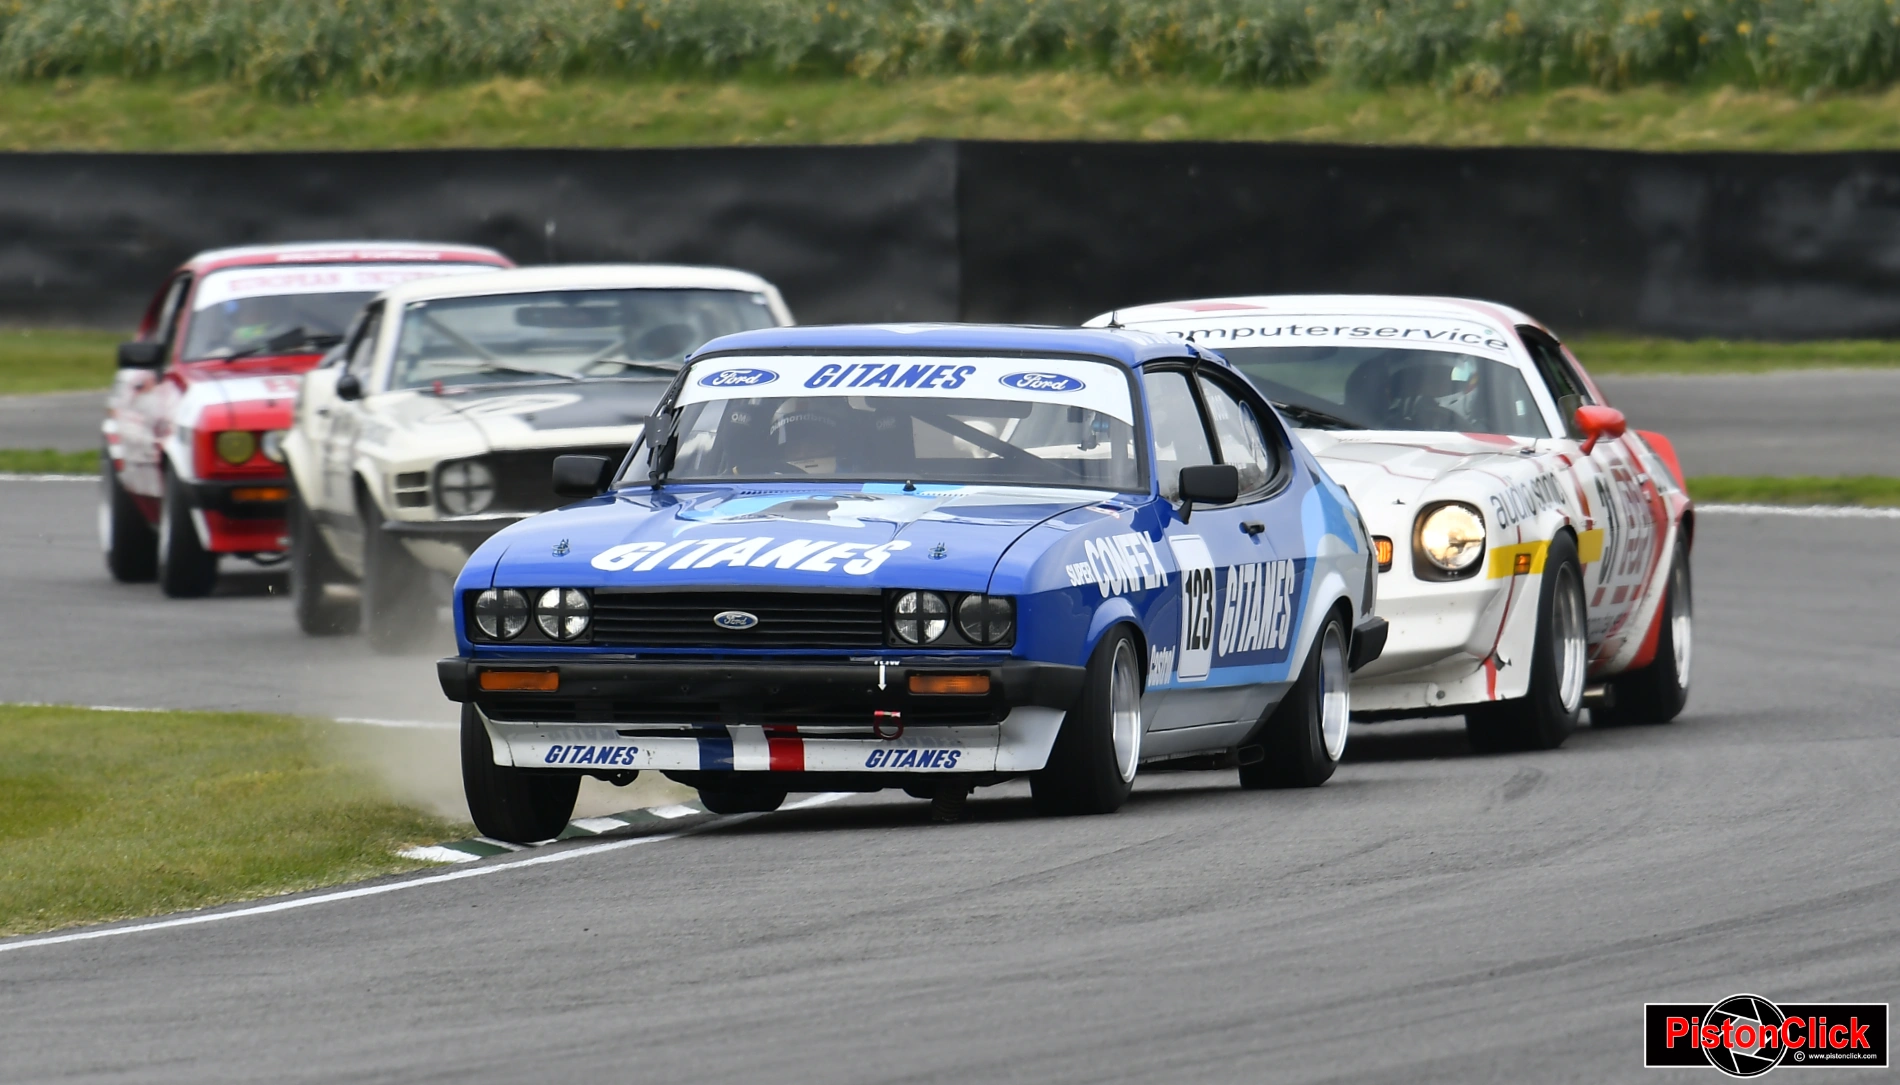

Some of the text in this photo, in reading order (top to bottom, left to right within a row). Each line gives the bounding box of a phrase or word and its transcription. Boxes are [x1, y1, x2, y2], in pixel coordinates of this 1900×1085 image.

[803, 363, 977, 390] GITANES
[1490, 470, 1566, 529] audio sonic
[591, 537, 912, 576] GITANES
[1066, 530, 1169, 599] SUPER CONFEX
[1185, 567, 1213, 651] 123
[1219, 558, 1296, 657] GITANES
[1148, 644, 1176, 687] Castrol
[544, 744, 639, 766] GITANES
[864, 748, 962, 769] GITANES
